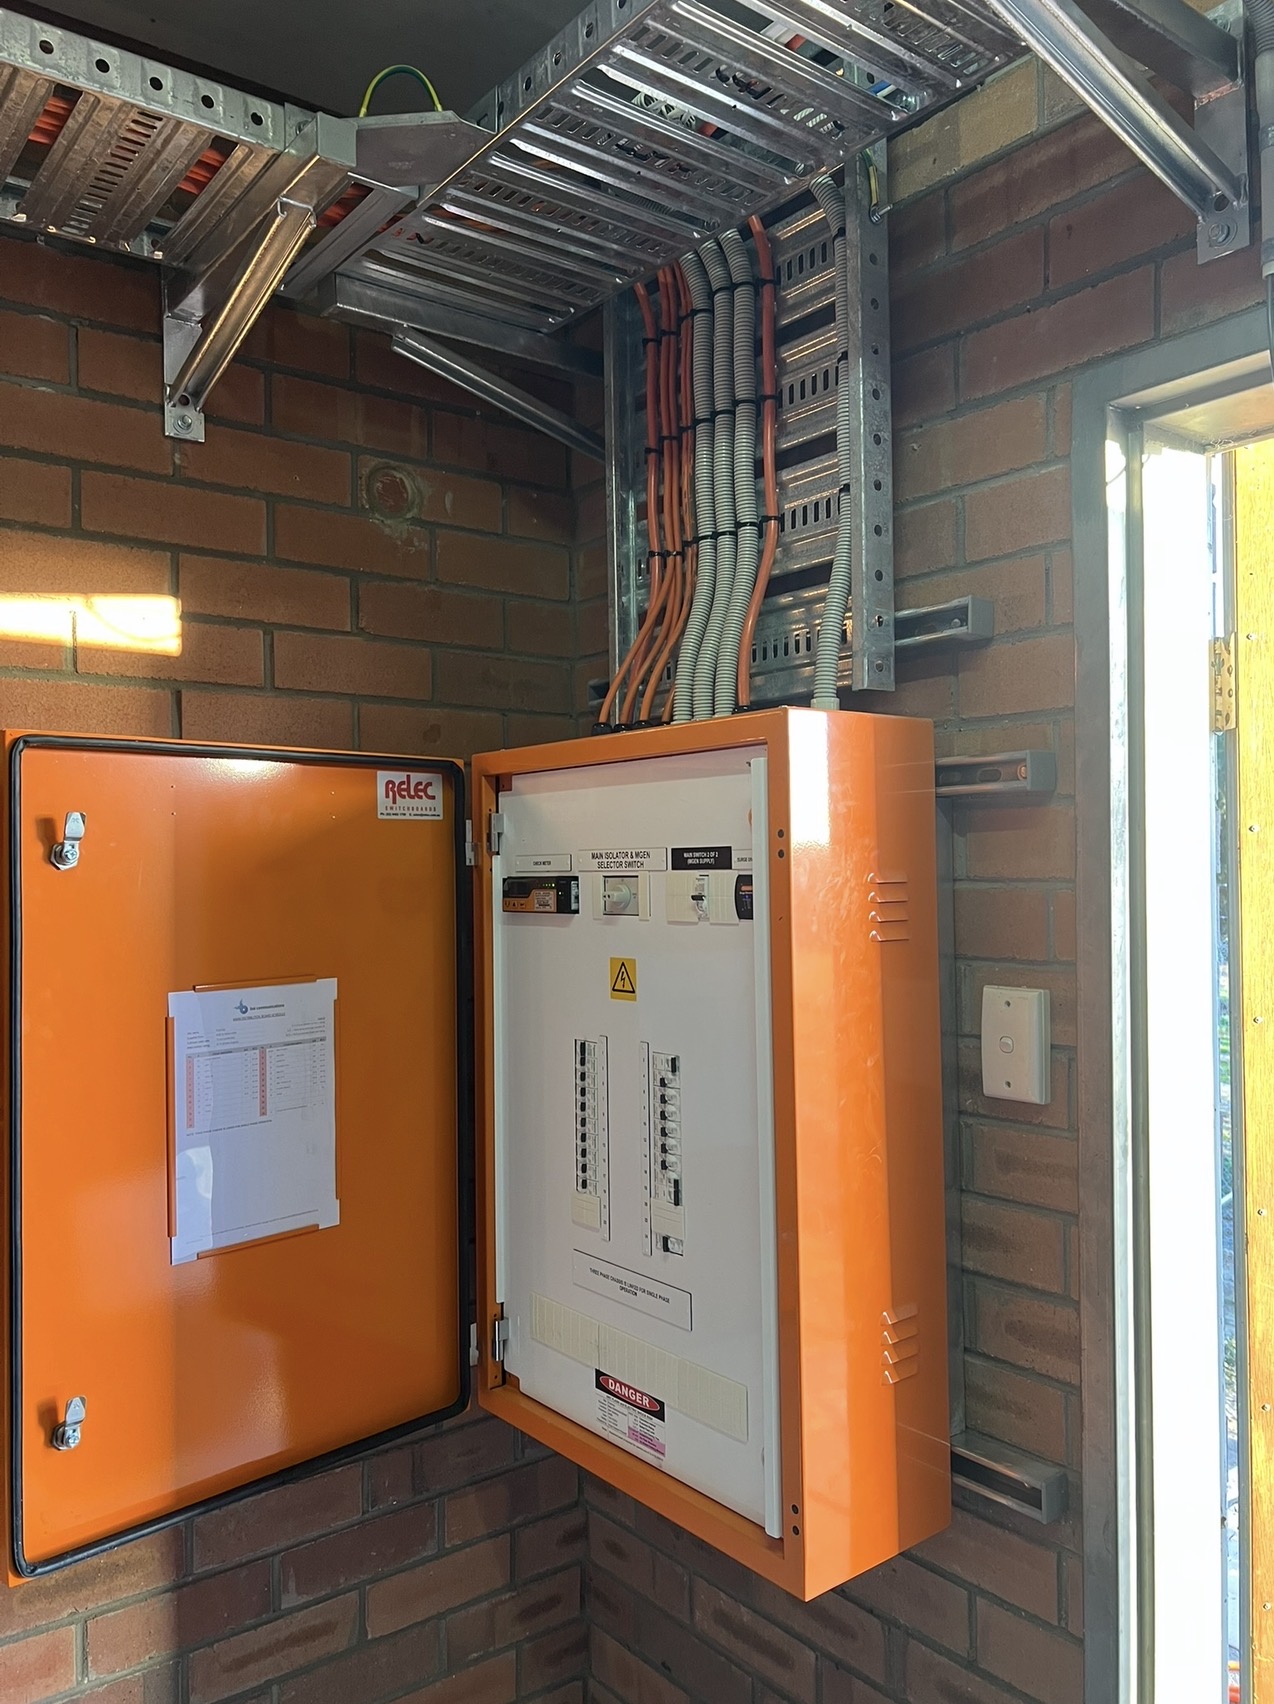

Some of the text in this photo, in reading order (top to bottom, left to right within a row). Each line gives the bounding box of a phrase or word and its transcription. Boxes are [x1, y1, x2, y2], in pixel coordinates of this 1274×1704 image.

[630, 851, 634, 859] &
[624, 860, 644, 868] SWITCH
[590, 1267, 600, 1276] THREE
[600, 1271, 610, 1280] PHASE
[610, 1276, 623, 1285] CHASSIS
[627, 1282, 639, 1291] LINKED
[646, 1289, 658, 1299] SINGLE
[658, 1294, 670, 1304] PHASE
[619, 1285, 638, 1297] OPERATION
[608, 1378, 650, 1408] DANGER
